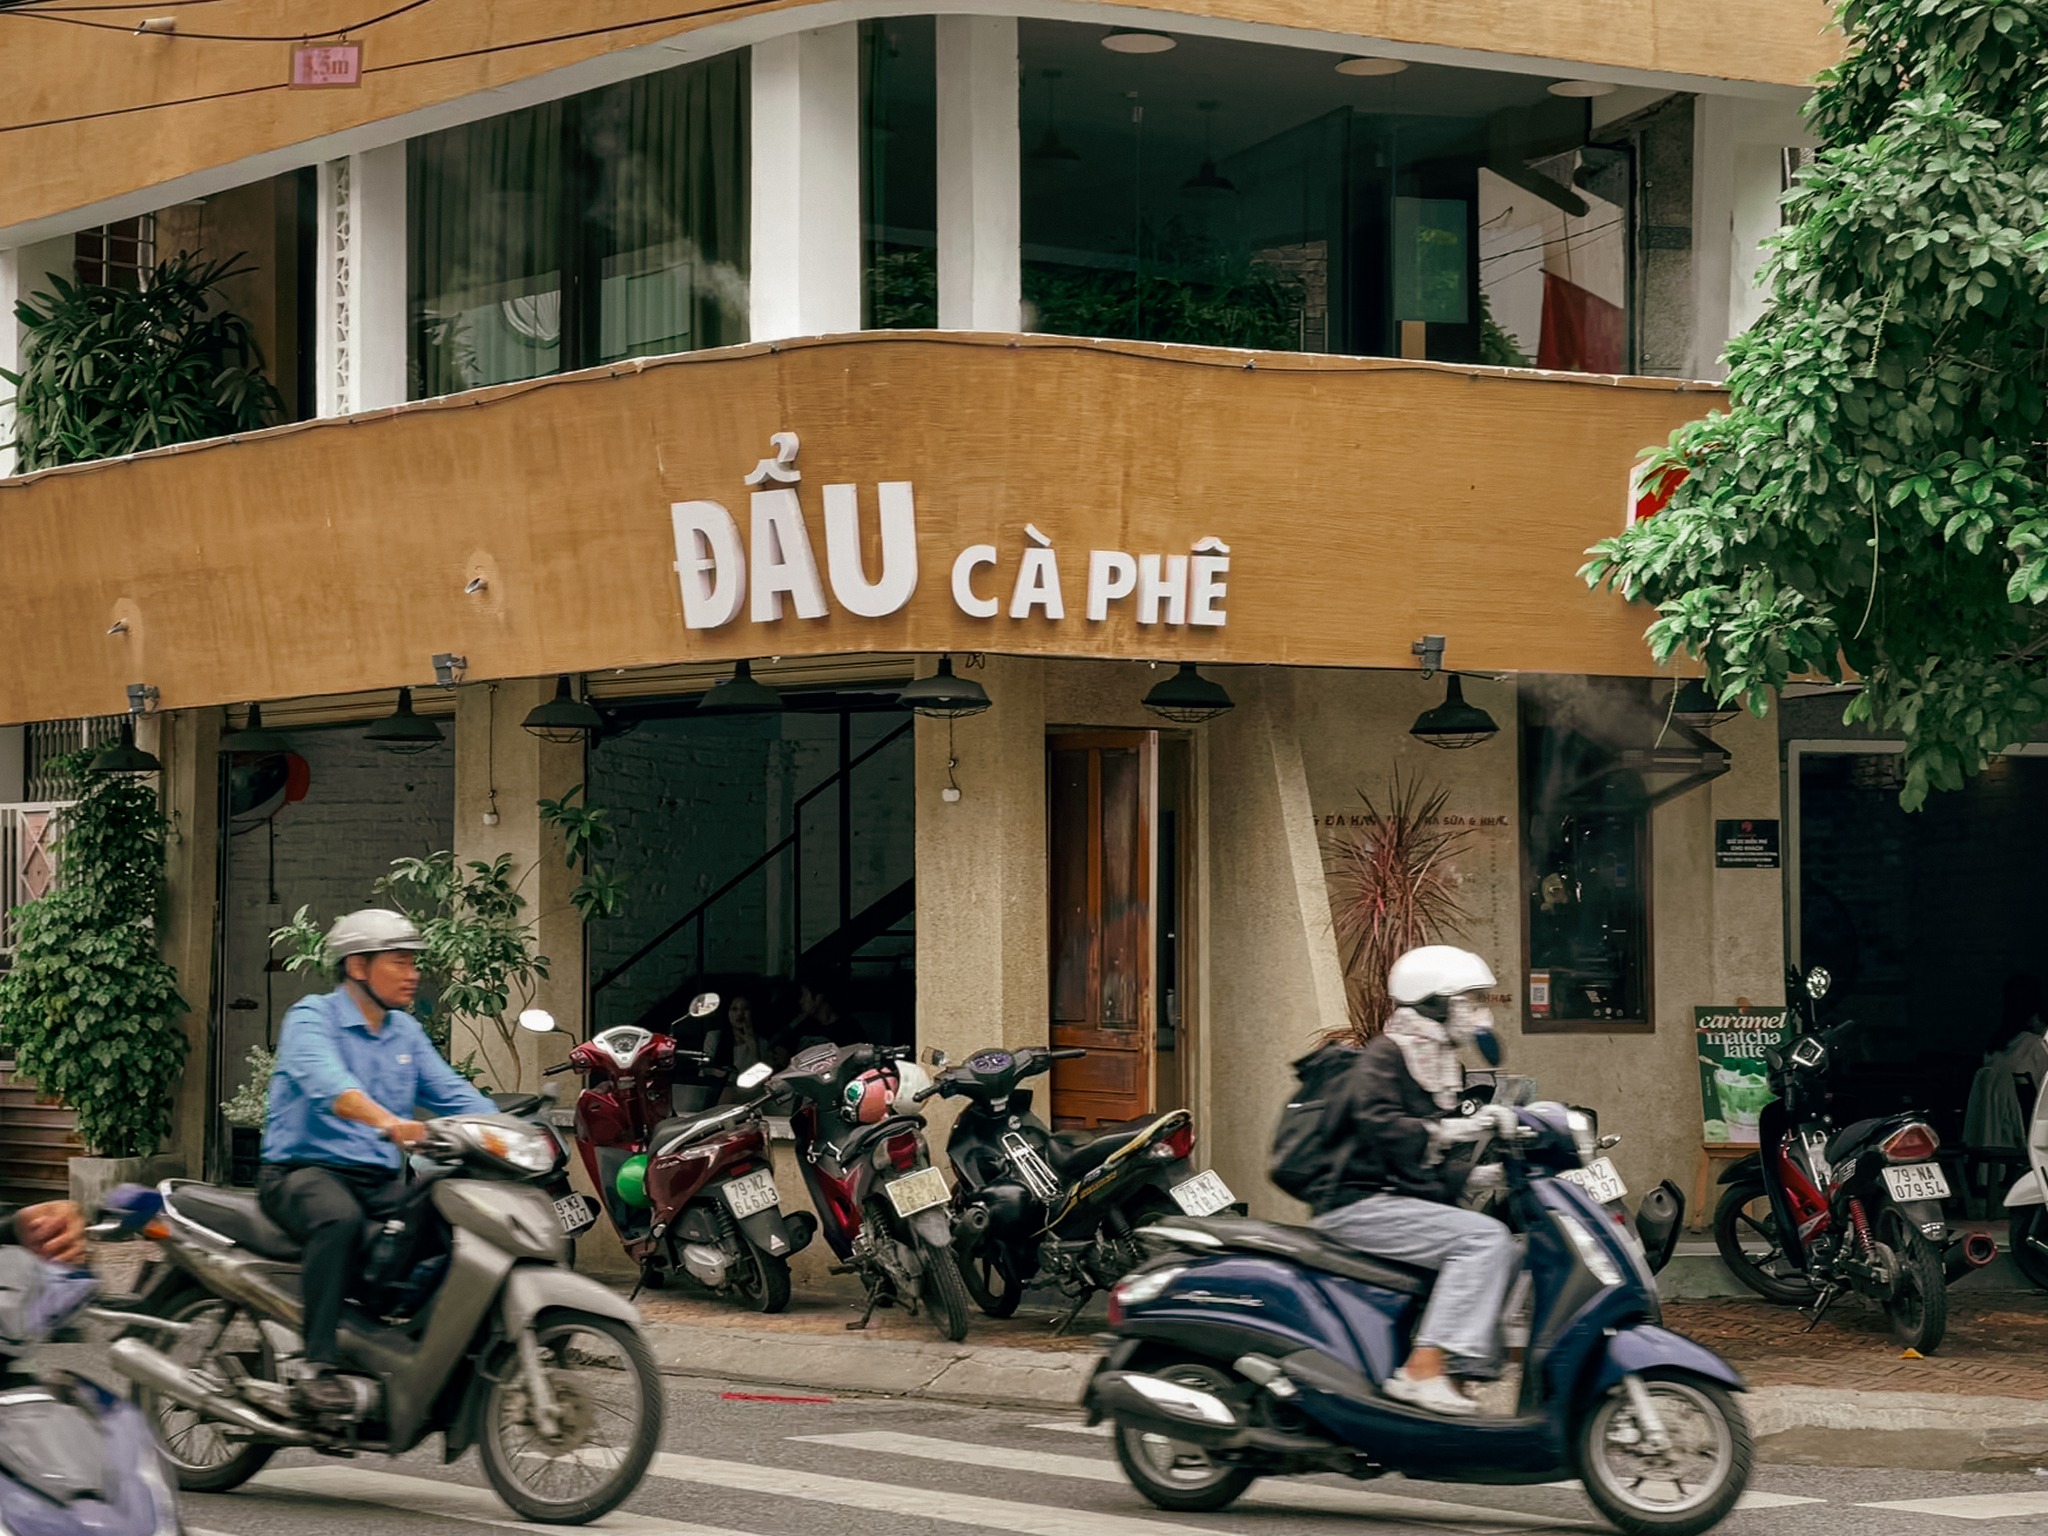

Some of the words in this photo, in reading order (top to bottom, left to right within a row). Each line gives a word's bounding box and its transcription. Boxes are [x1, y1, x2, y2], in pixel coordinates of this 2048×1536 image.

[671, 432, 919, 629] ĐẨU
[951, 523, 1064, 619] CÀ
[1086, 536, 1231, 627] PHÊ
[1698, 1012, 1788, 1029] caramel
[1706, 1029, 1781, 1045] matcha
[1724, 1043, 1767, 1058] latte
[1892, 1166, 1936, 1184] 79-NA
[730, 1174, 767, 1199] 79-N2
[1587, 1177, 1620, 1202] 6.97
[1895, 1181, 1945, 1199] 079.54
[554, 1195, 580, 1215] 9-N3
[734, 1187, 778, 1215] 646.03
